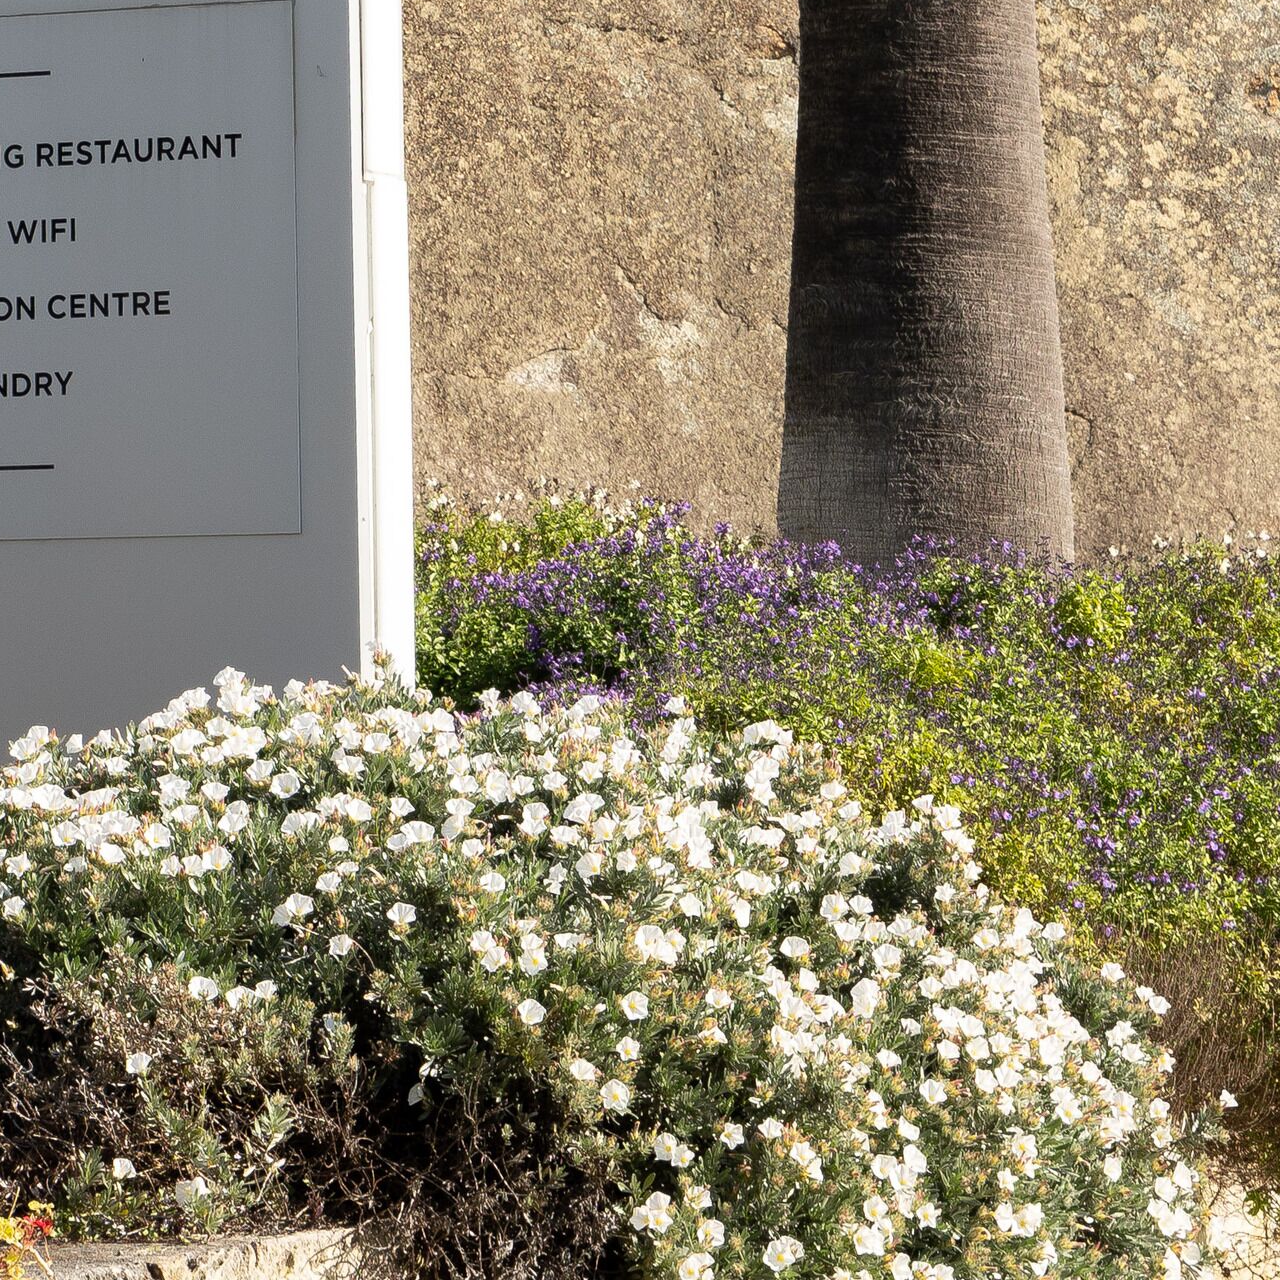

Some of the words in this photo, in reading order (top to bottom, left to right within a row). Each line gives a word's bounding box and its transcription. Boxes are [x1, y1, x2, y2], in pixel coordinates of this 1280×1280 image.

[36, 133, 242, 168] RESTAURANT
[7, 217, 76, 245] WIFI
[47, 290, 171, 320] CENTRE
